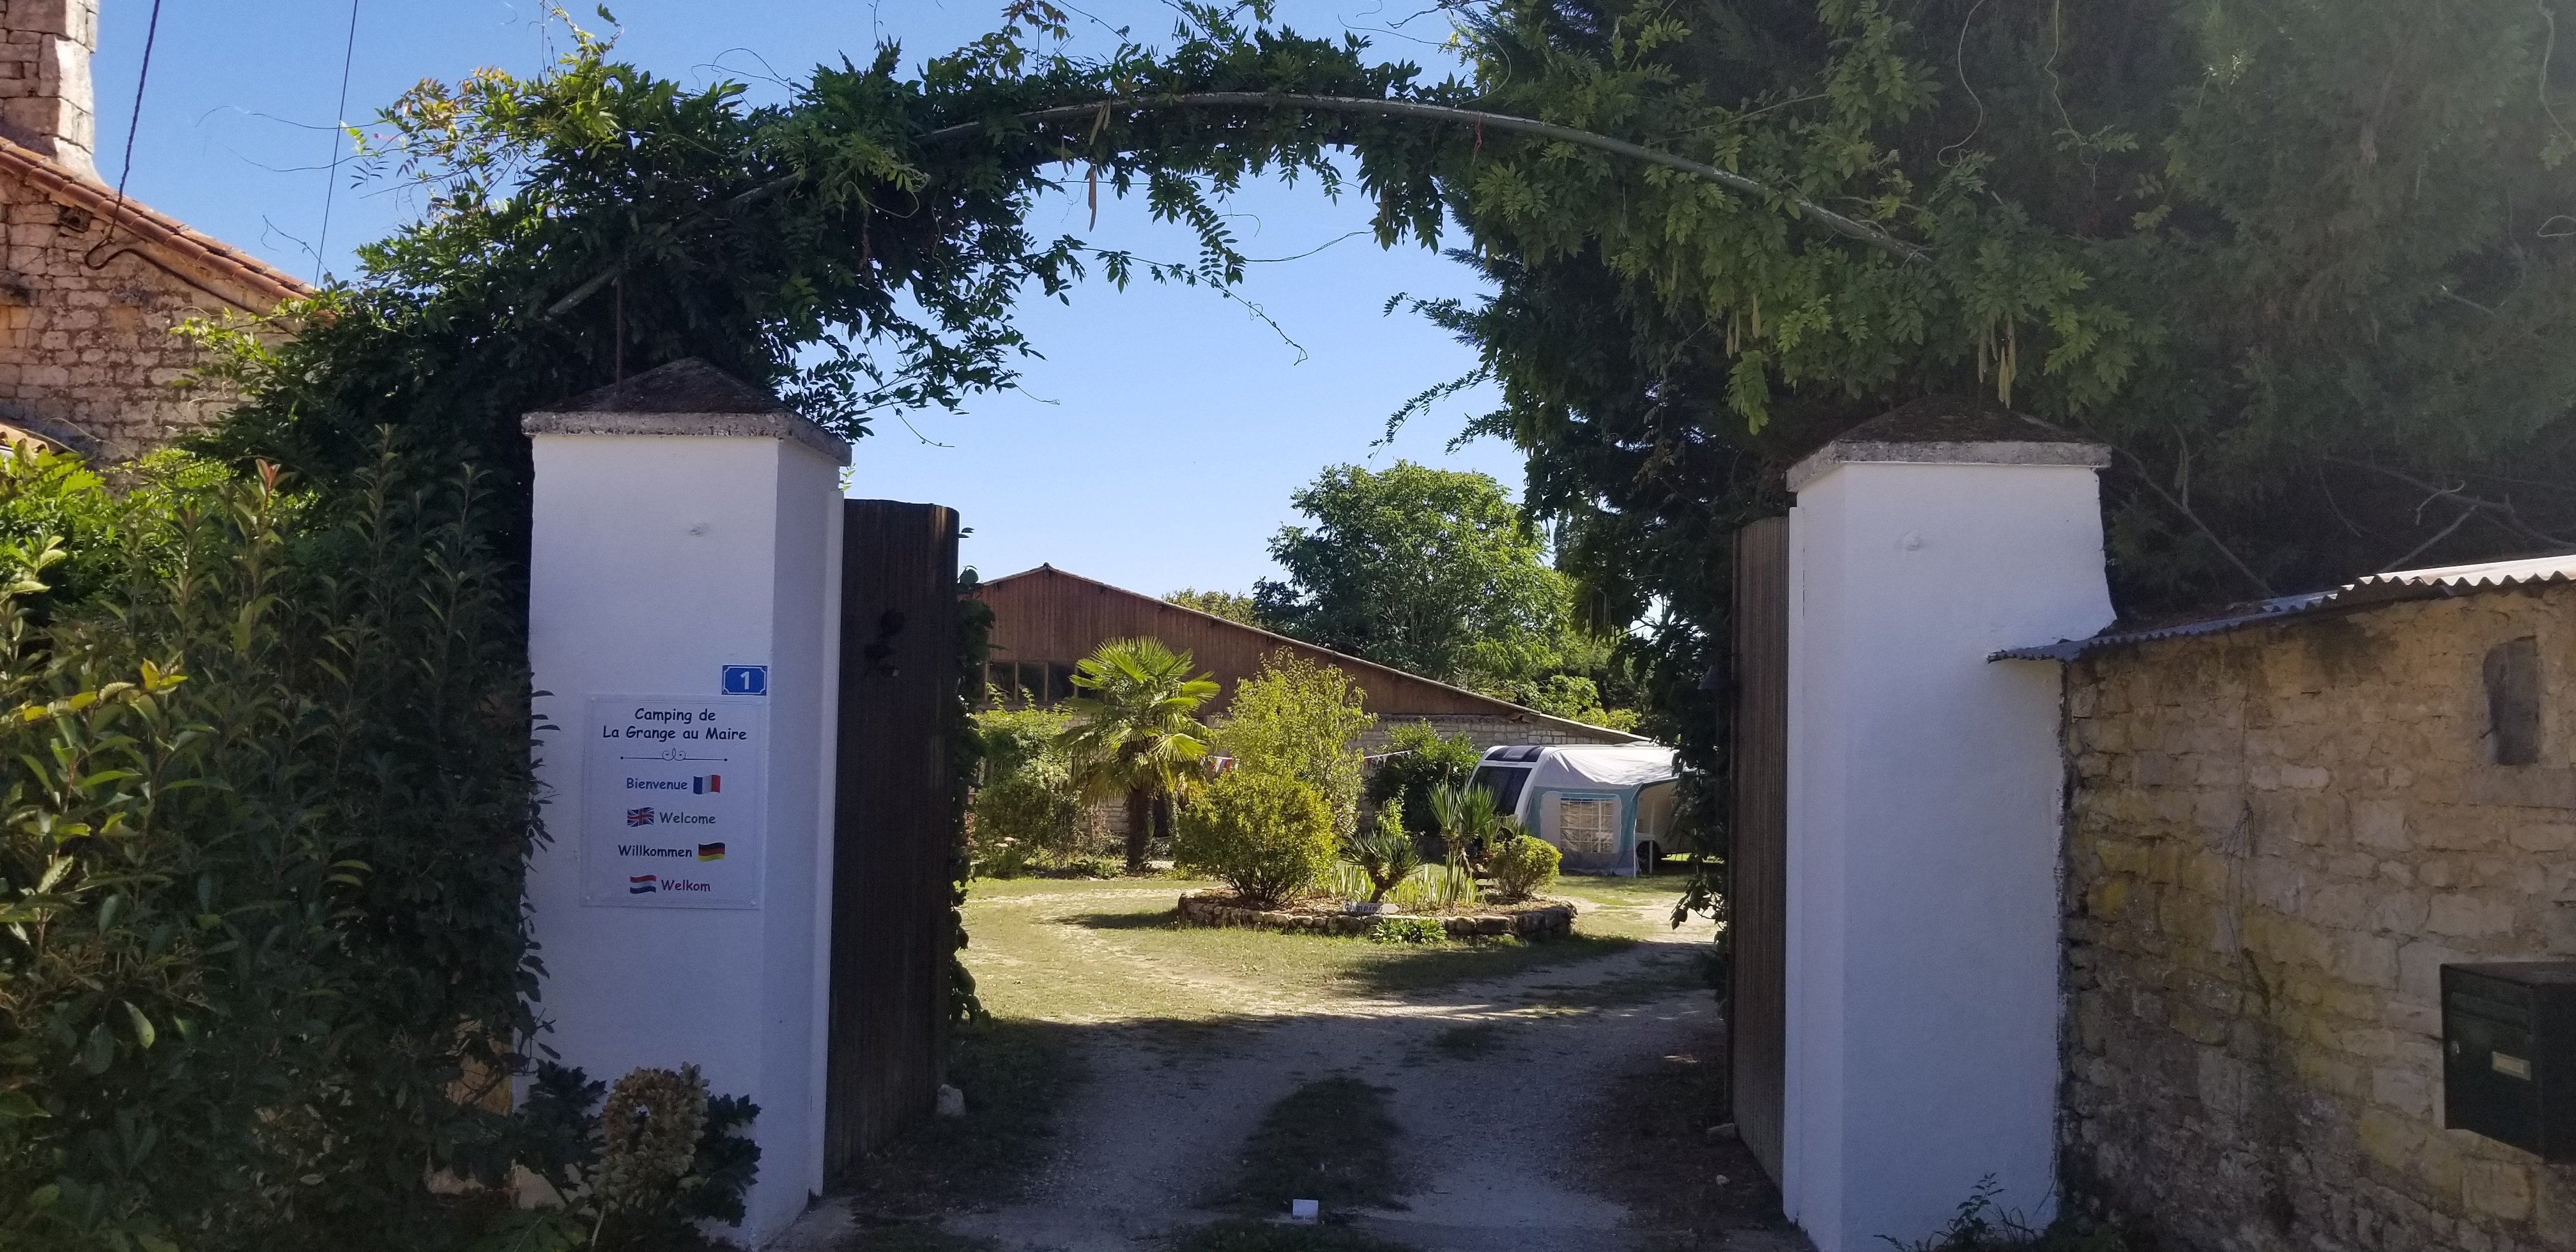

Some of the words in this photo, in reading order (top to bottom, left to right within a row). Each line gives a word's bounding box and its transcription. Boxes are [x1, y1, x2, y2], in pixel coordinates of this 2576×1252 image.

[740, 671, 749, 690] 1
[635, 707, 692, 724] Camping
[699, 708, 716, 721] de
[602, 725, 619, 738] La
[626, 726, 676, 742] Grange
[683, 729, 698, 740] au
[705, 727, 747, 740] Maire
[627, 777, 688, 790] Bienvenue
[660, 812, 716, 824] Welcome
[618, 844, 693, 858] Willkommen
[661, 880, 710, 892] Welkom
[1344, 903, 1383, 913] Camping
